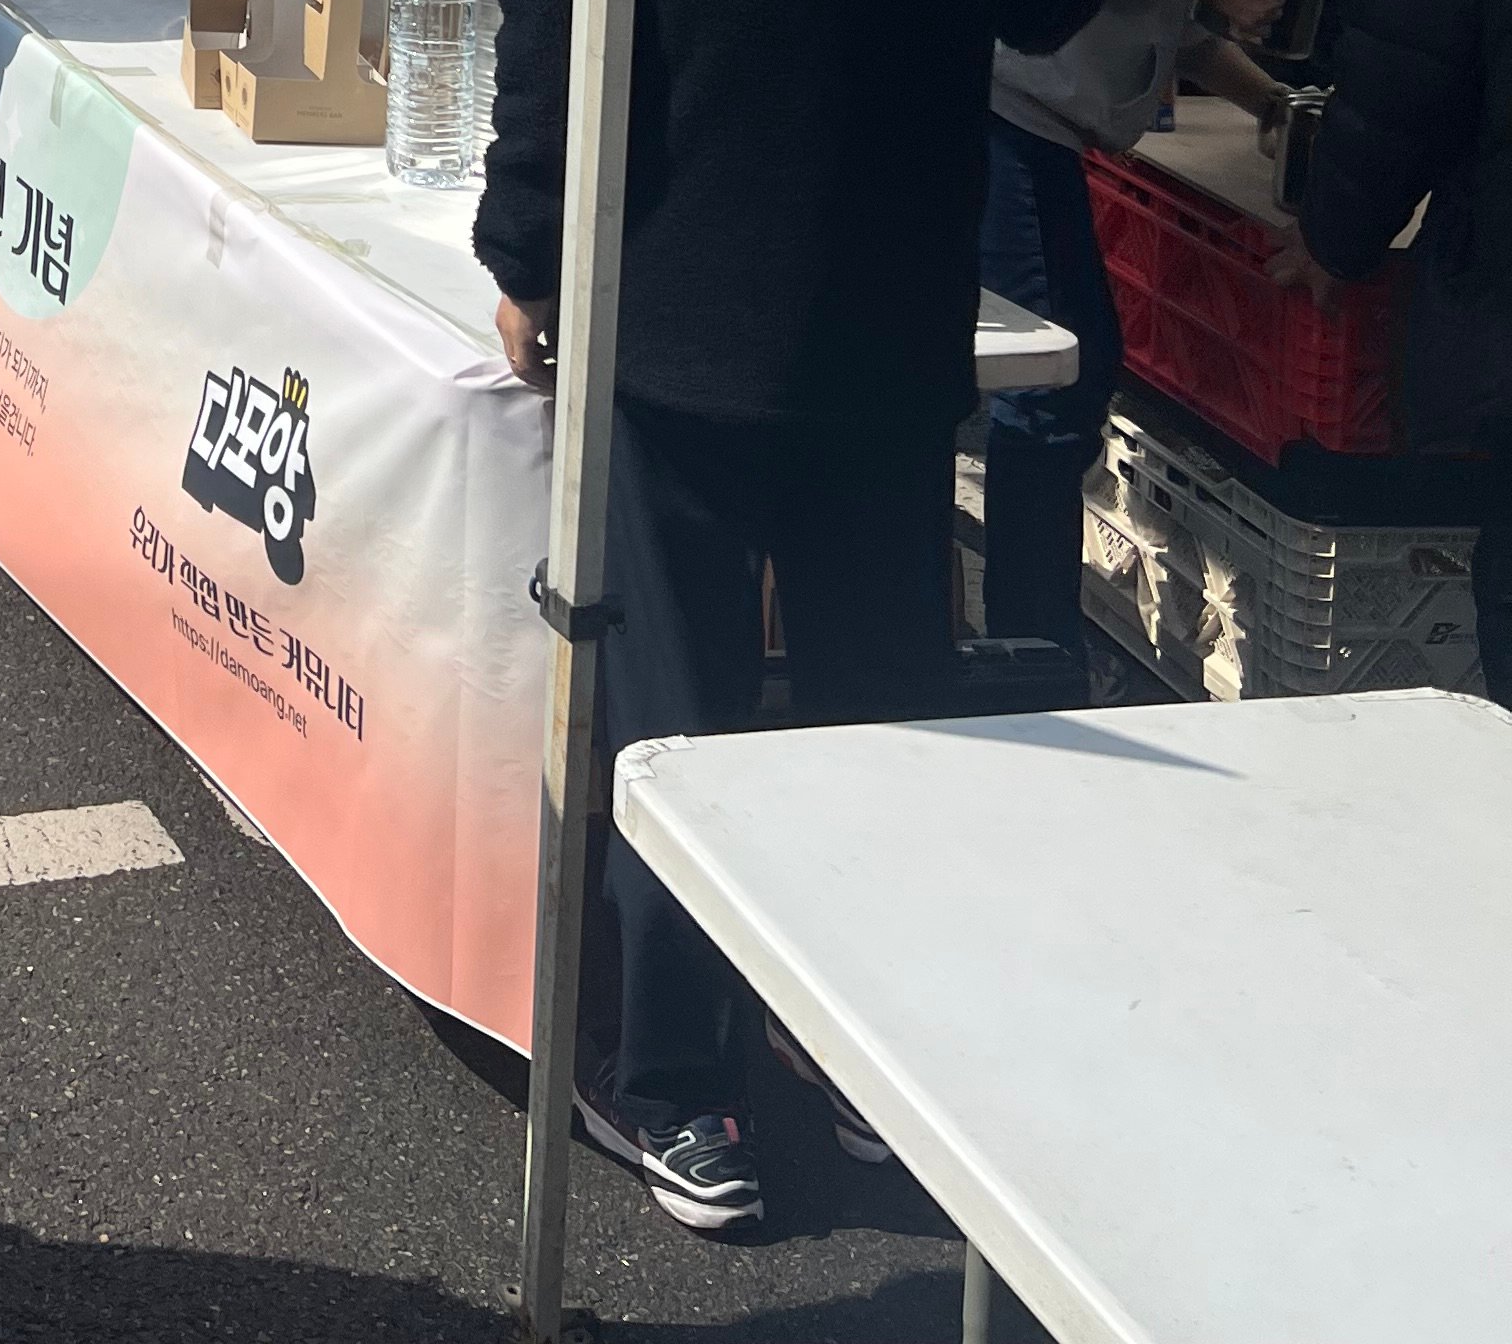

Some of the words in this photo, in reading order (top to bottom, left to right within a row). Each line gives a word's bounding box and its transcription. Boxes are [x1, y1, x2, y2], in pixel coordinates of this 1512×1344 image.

[11, 174, 74, 306] 기념
[11, 349, 50, 414] 되기까지,
[191, 373, 308, 541] 다모앙
[128, 505, 175, 585] 우리가
[179, 553, 221, 623] 직접
[225, 591, 275, 657] 만든
[279, 627, 365, 743] 커뮤니티
[171, 607, 309, 739] https://damoang.net
